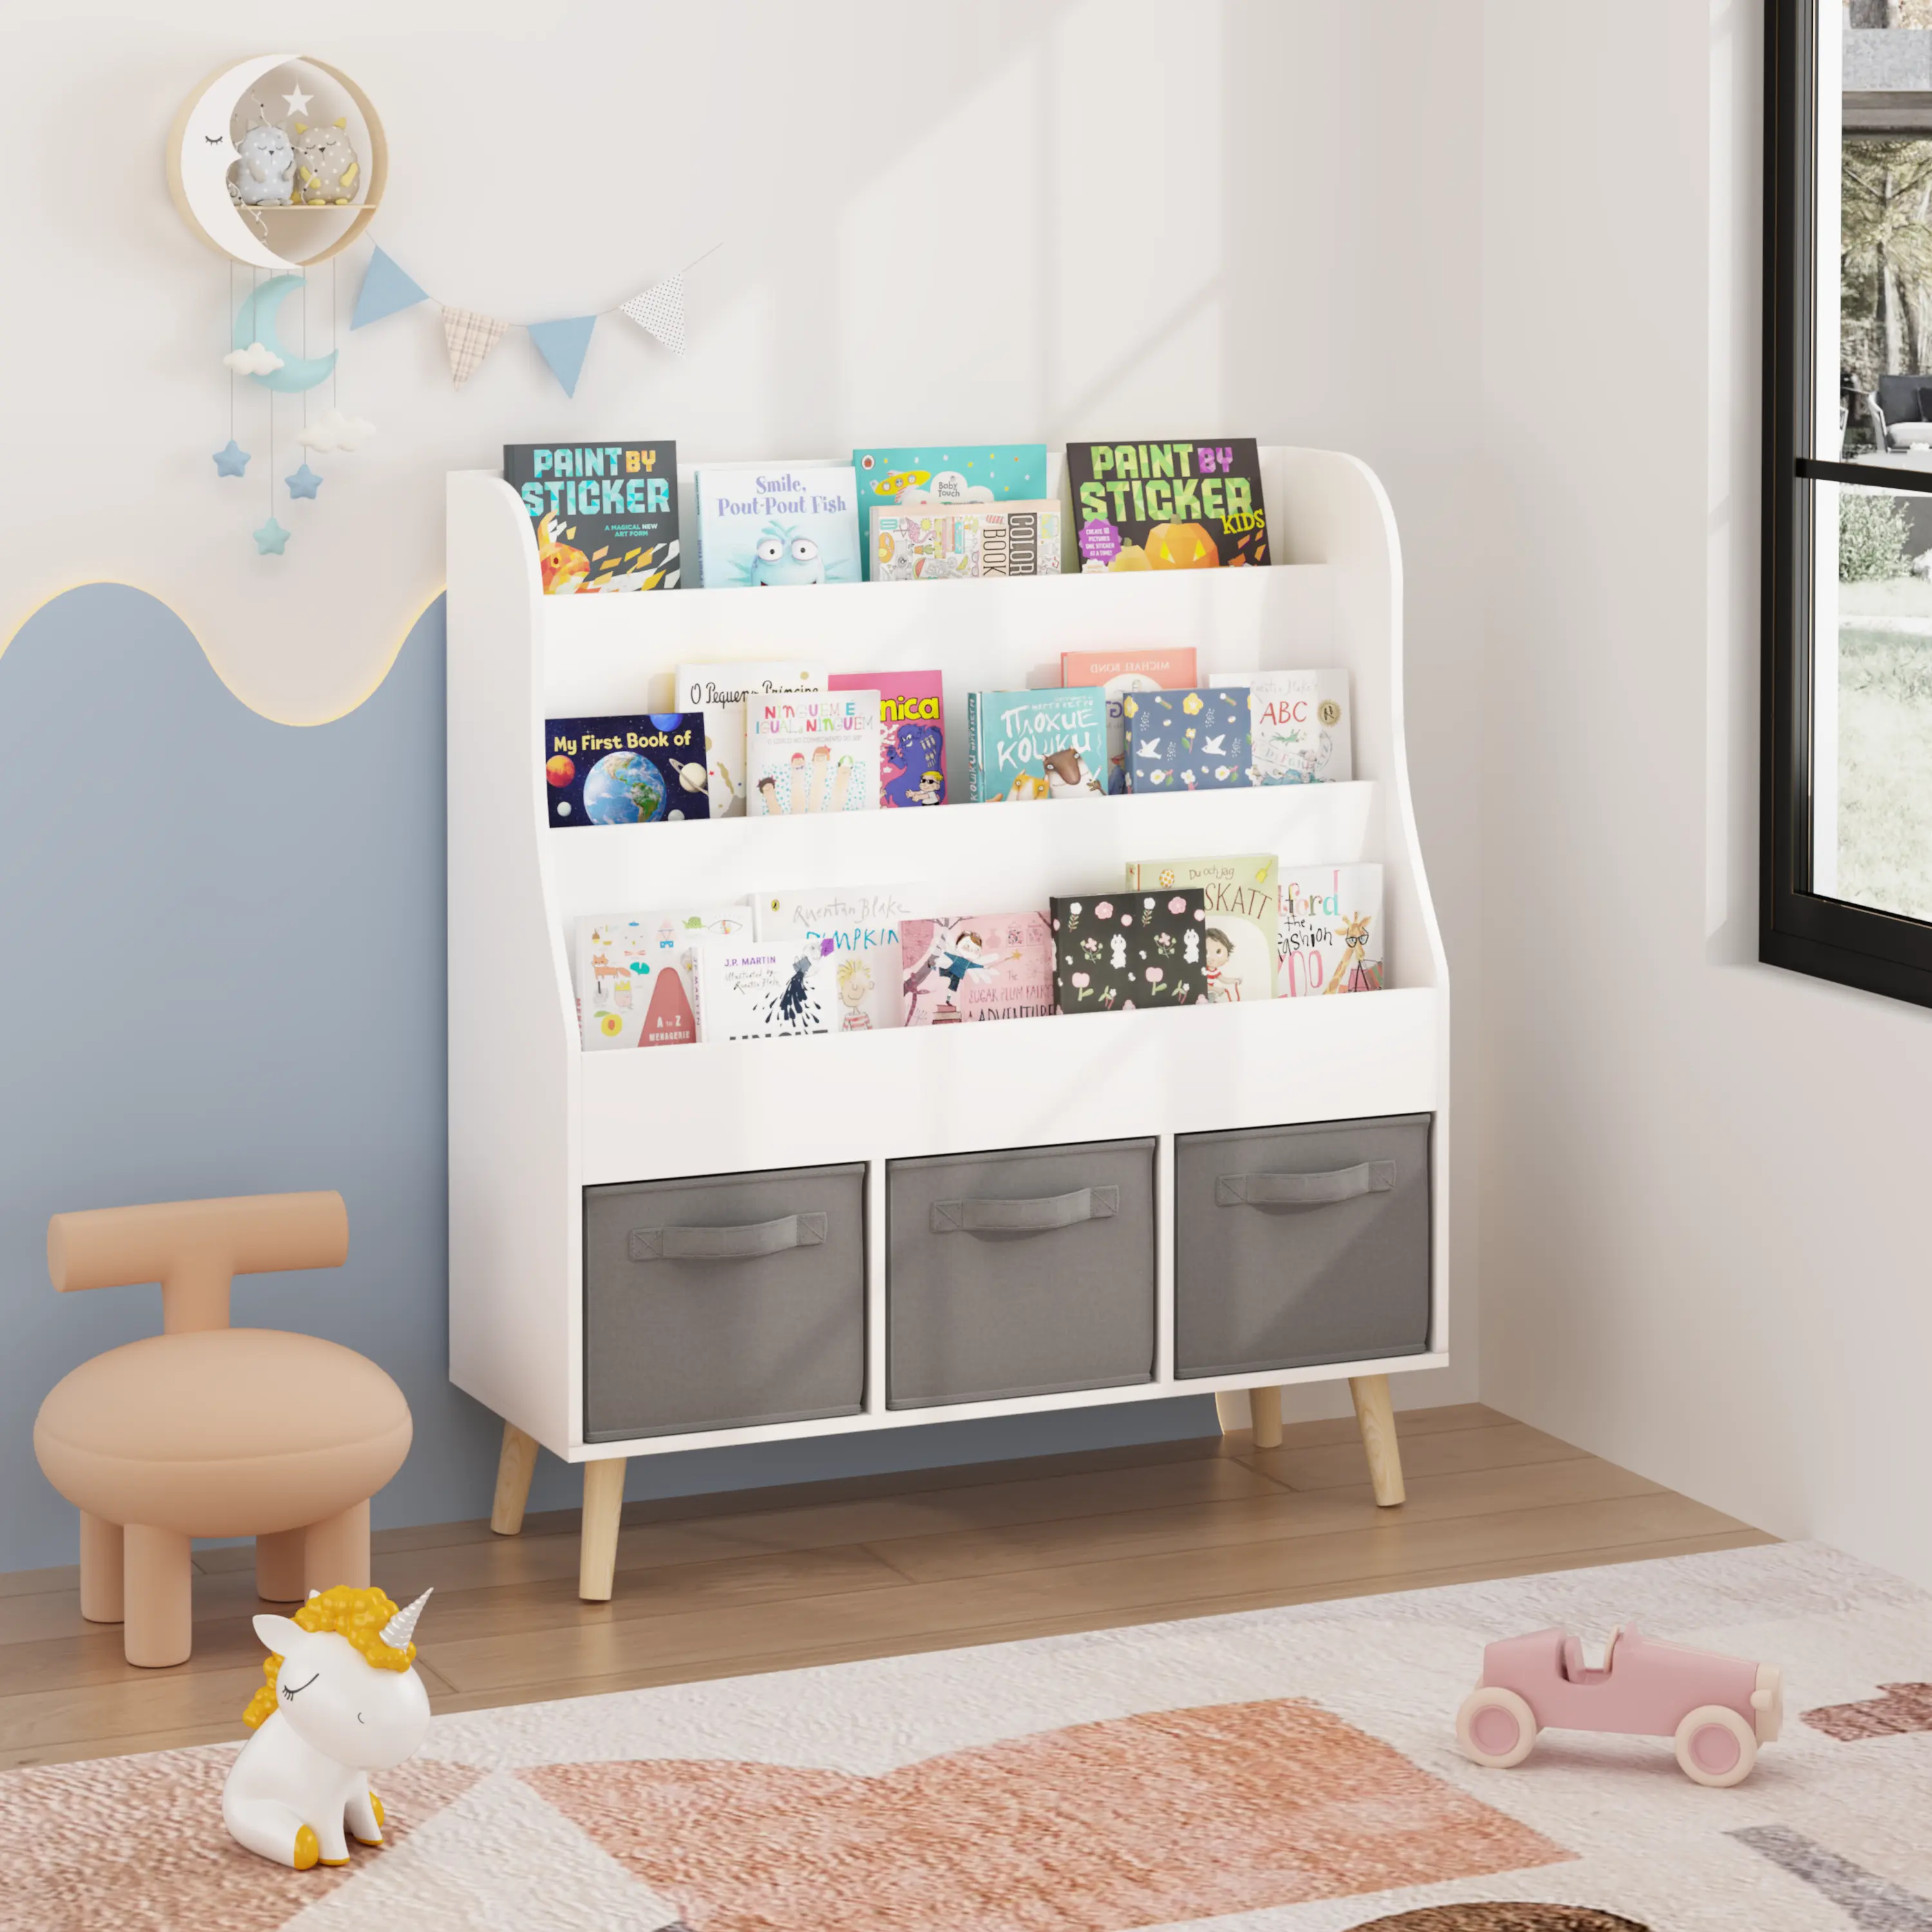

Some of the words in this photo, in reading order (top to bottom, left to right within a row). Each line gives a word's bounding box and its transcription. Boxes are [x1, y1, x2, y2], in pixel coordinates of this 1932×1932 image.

[533, 447, 622, 478] PAINT
[625, 450, 656, 473] BY
[1090, 444, 1193, 480] PAINT
[1197, 447, 1233, 473] BY
[756, 473, 806, 495] Smile,
[938, 481, 958, 491] Baby
[938, 489, 960, 498] Touch
[521, 478, 670, 516] STICKER
[716, 496, 807, 516] Pout-Pout
[810, 495, 847, 514] Fish
[1079, 477, 1253, 522] STICKER
[1220, 509, 1265, 535] KIDS
[983, 529, 1007, 575] BOOK
[1009, 515, 1035, 576] COLOR
[690, 683, 701, 705] O
[1260, 701, 1308, 726] ABC
[755, 719, 795, 735] IGUAL
[554, 735, 577, 755] My
[582, 734, 623, 751] First
[627, 732, 669, 749] Book
[673, 730, 692, 746] of
[1189, 869, 1201, 880] Du
[1203, 864, 1218, 876] och
[1215, 865, 1235, 880] jag
[1204, 882, 1273, 920] SKATT
[1284, 916, 1305, 931] the
[741, 956, 777, 966] MARTIN
[656, 1016, 663, 1028] A
[675, 1014, 681, 1027] Z
[649, 1030, 690, 1041] MENAGERIE
